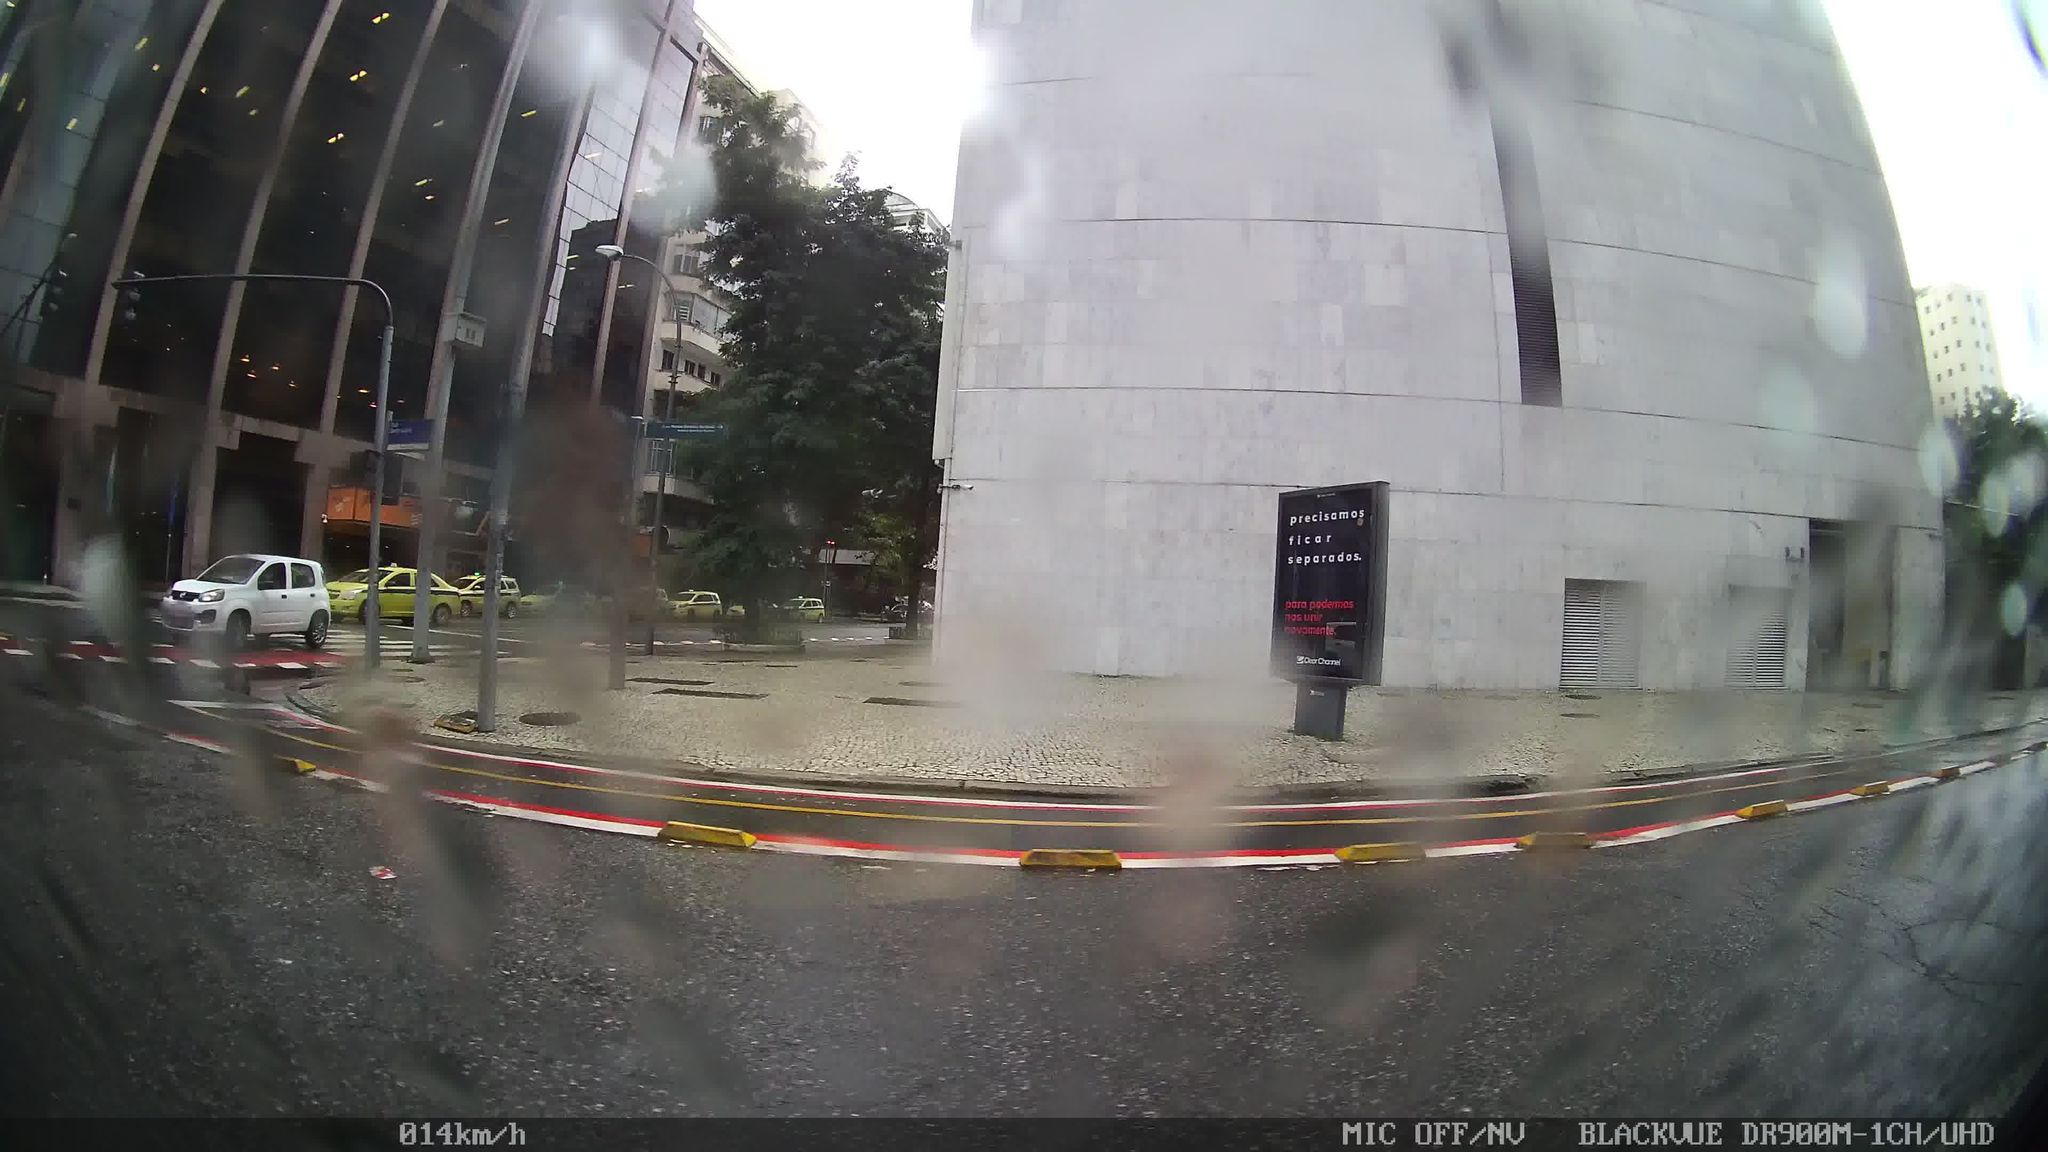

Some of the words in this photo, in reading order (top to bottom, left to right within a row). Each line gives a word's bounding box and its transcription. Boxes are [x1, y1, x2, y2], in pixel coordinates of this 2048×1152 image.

[1289, 509, 1365, 527] precisamos
[1288, 534, 1333, 546] ficar
[1287, 551, 1363, 567] separados.
[1285, 600, 1307, 610] para
[1284, 613, 1304, 623] nos
[1304, 613, 1323, 623] unir
